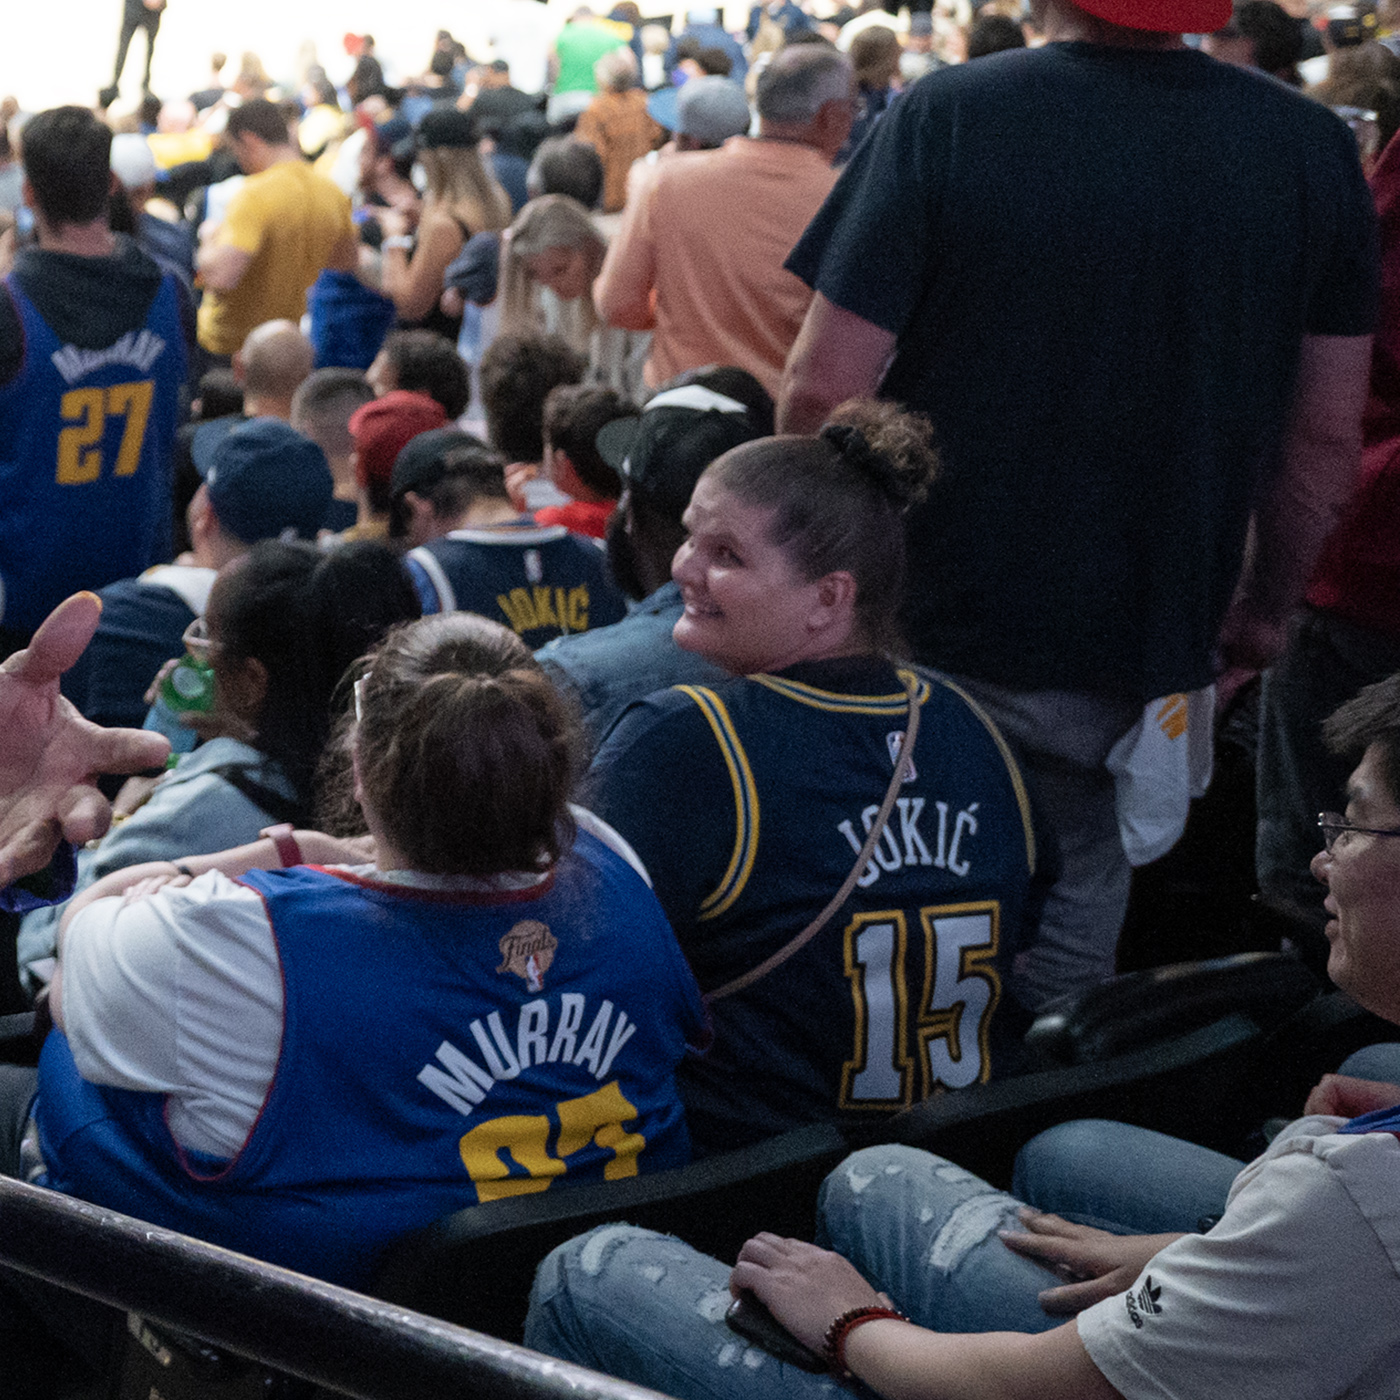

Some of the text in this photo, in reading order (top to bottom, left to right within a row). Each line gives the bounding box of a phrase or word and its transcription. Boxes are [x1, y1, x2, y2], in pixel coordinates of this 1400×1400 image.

[55, 378, 155, 486] 27
[837, 797, 981, 888] JOKIĆ
[416, 992, 637, 1117] MURRAY
[839, 900, 1001, 1122] 15
